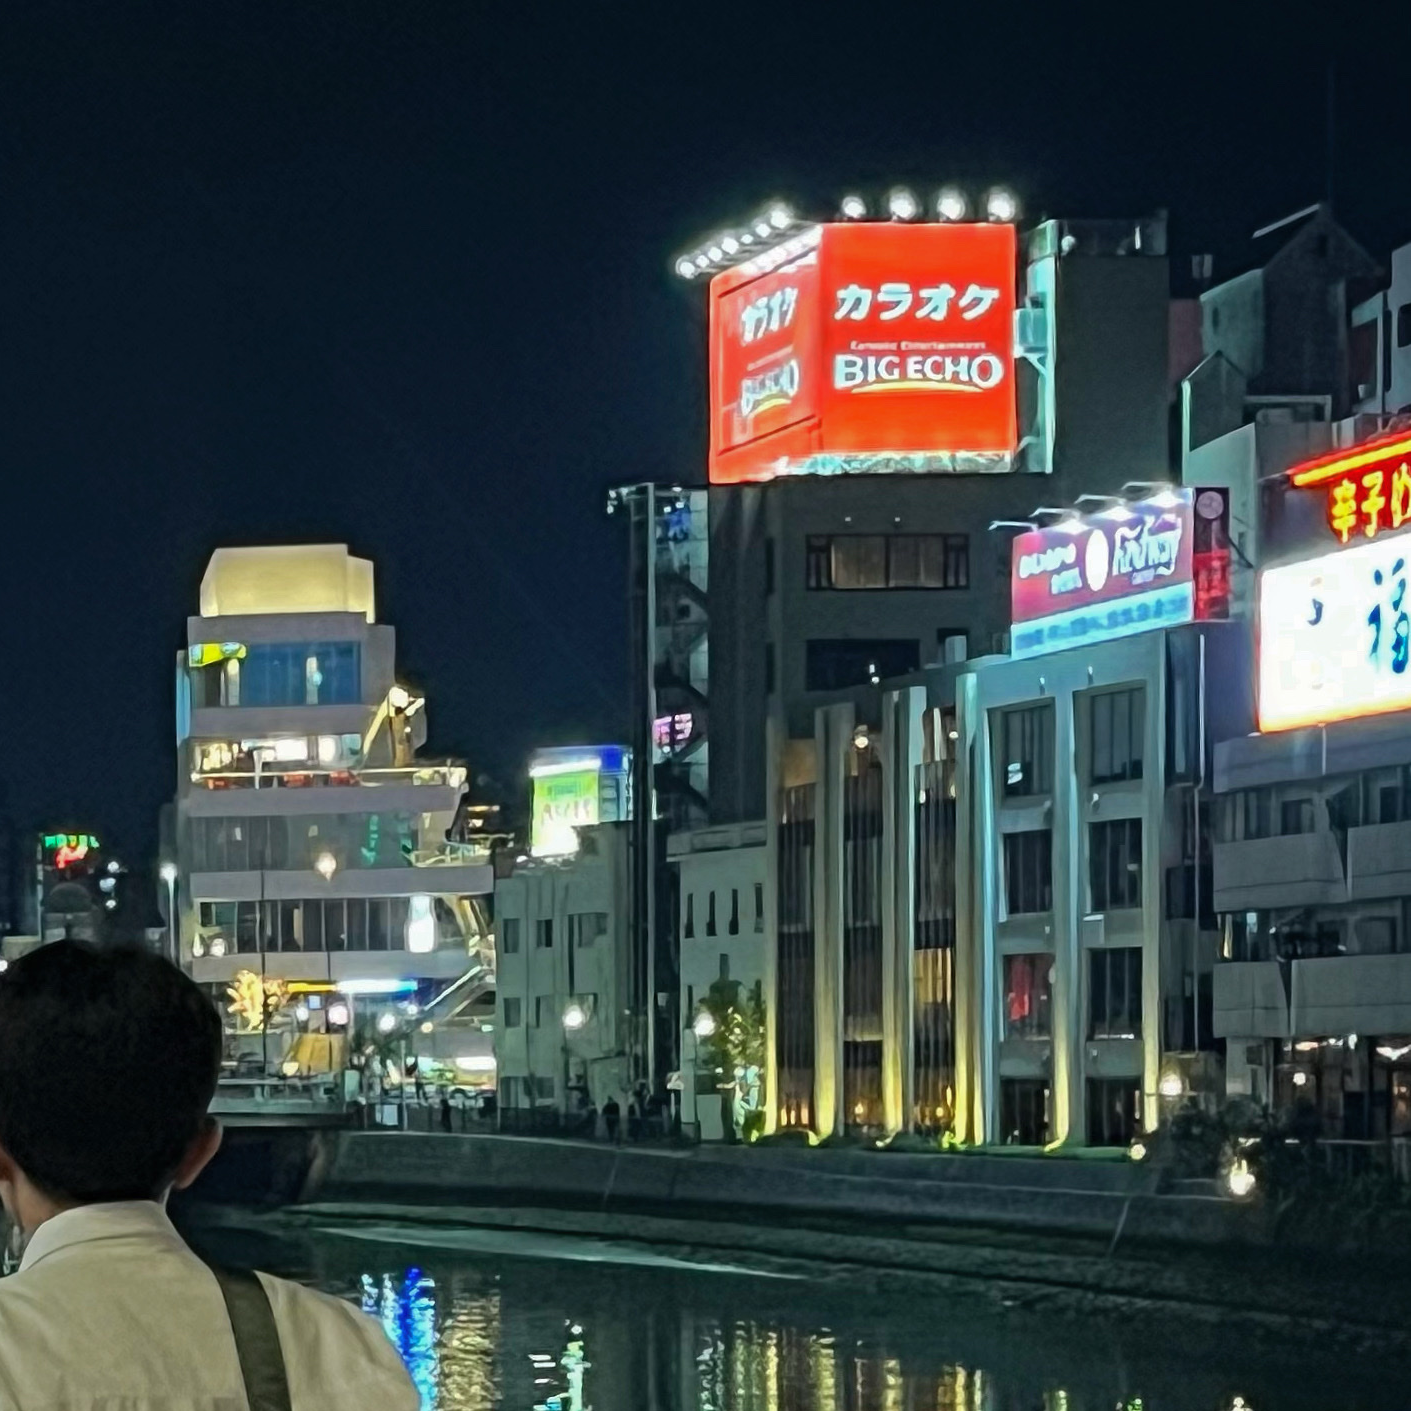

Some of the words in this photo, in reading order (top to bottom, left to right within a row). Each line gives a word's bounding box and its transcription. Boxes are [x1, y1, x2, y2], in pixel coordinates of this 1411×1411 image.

[834, 283, 1000, 321] カラオケ
[834, 354, 900, 389] BIG
[906, 353, 1004, 388] ECHO
